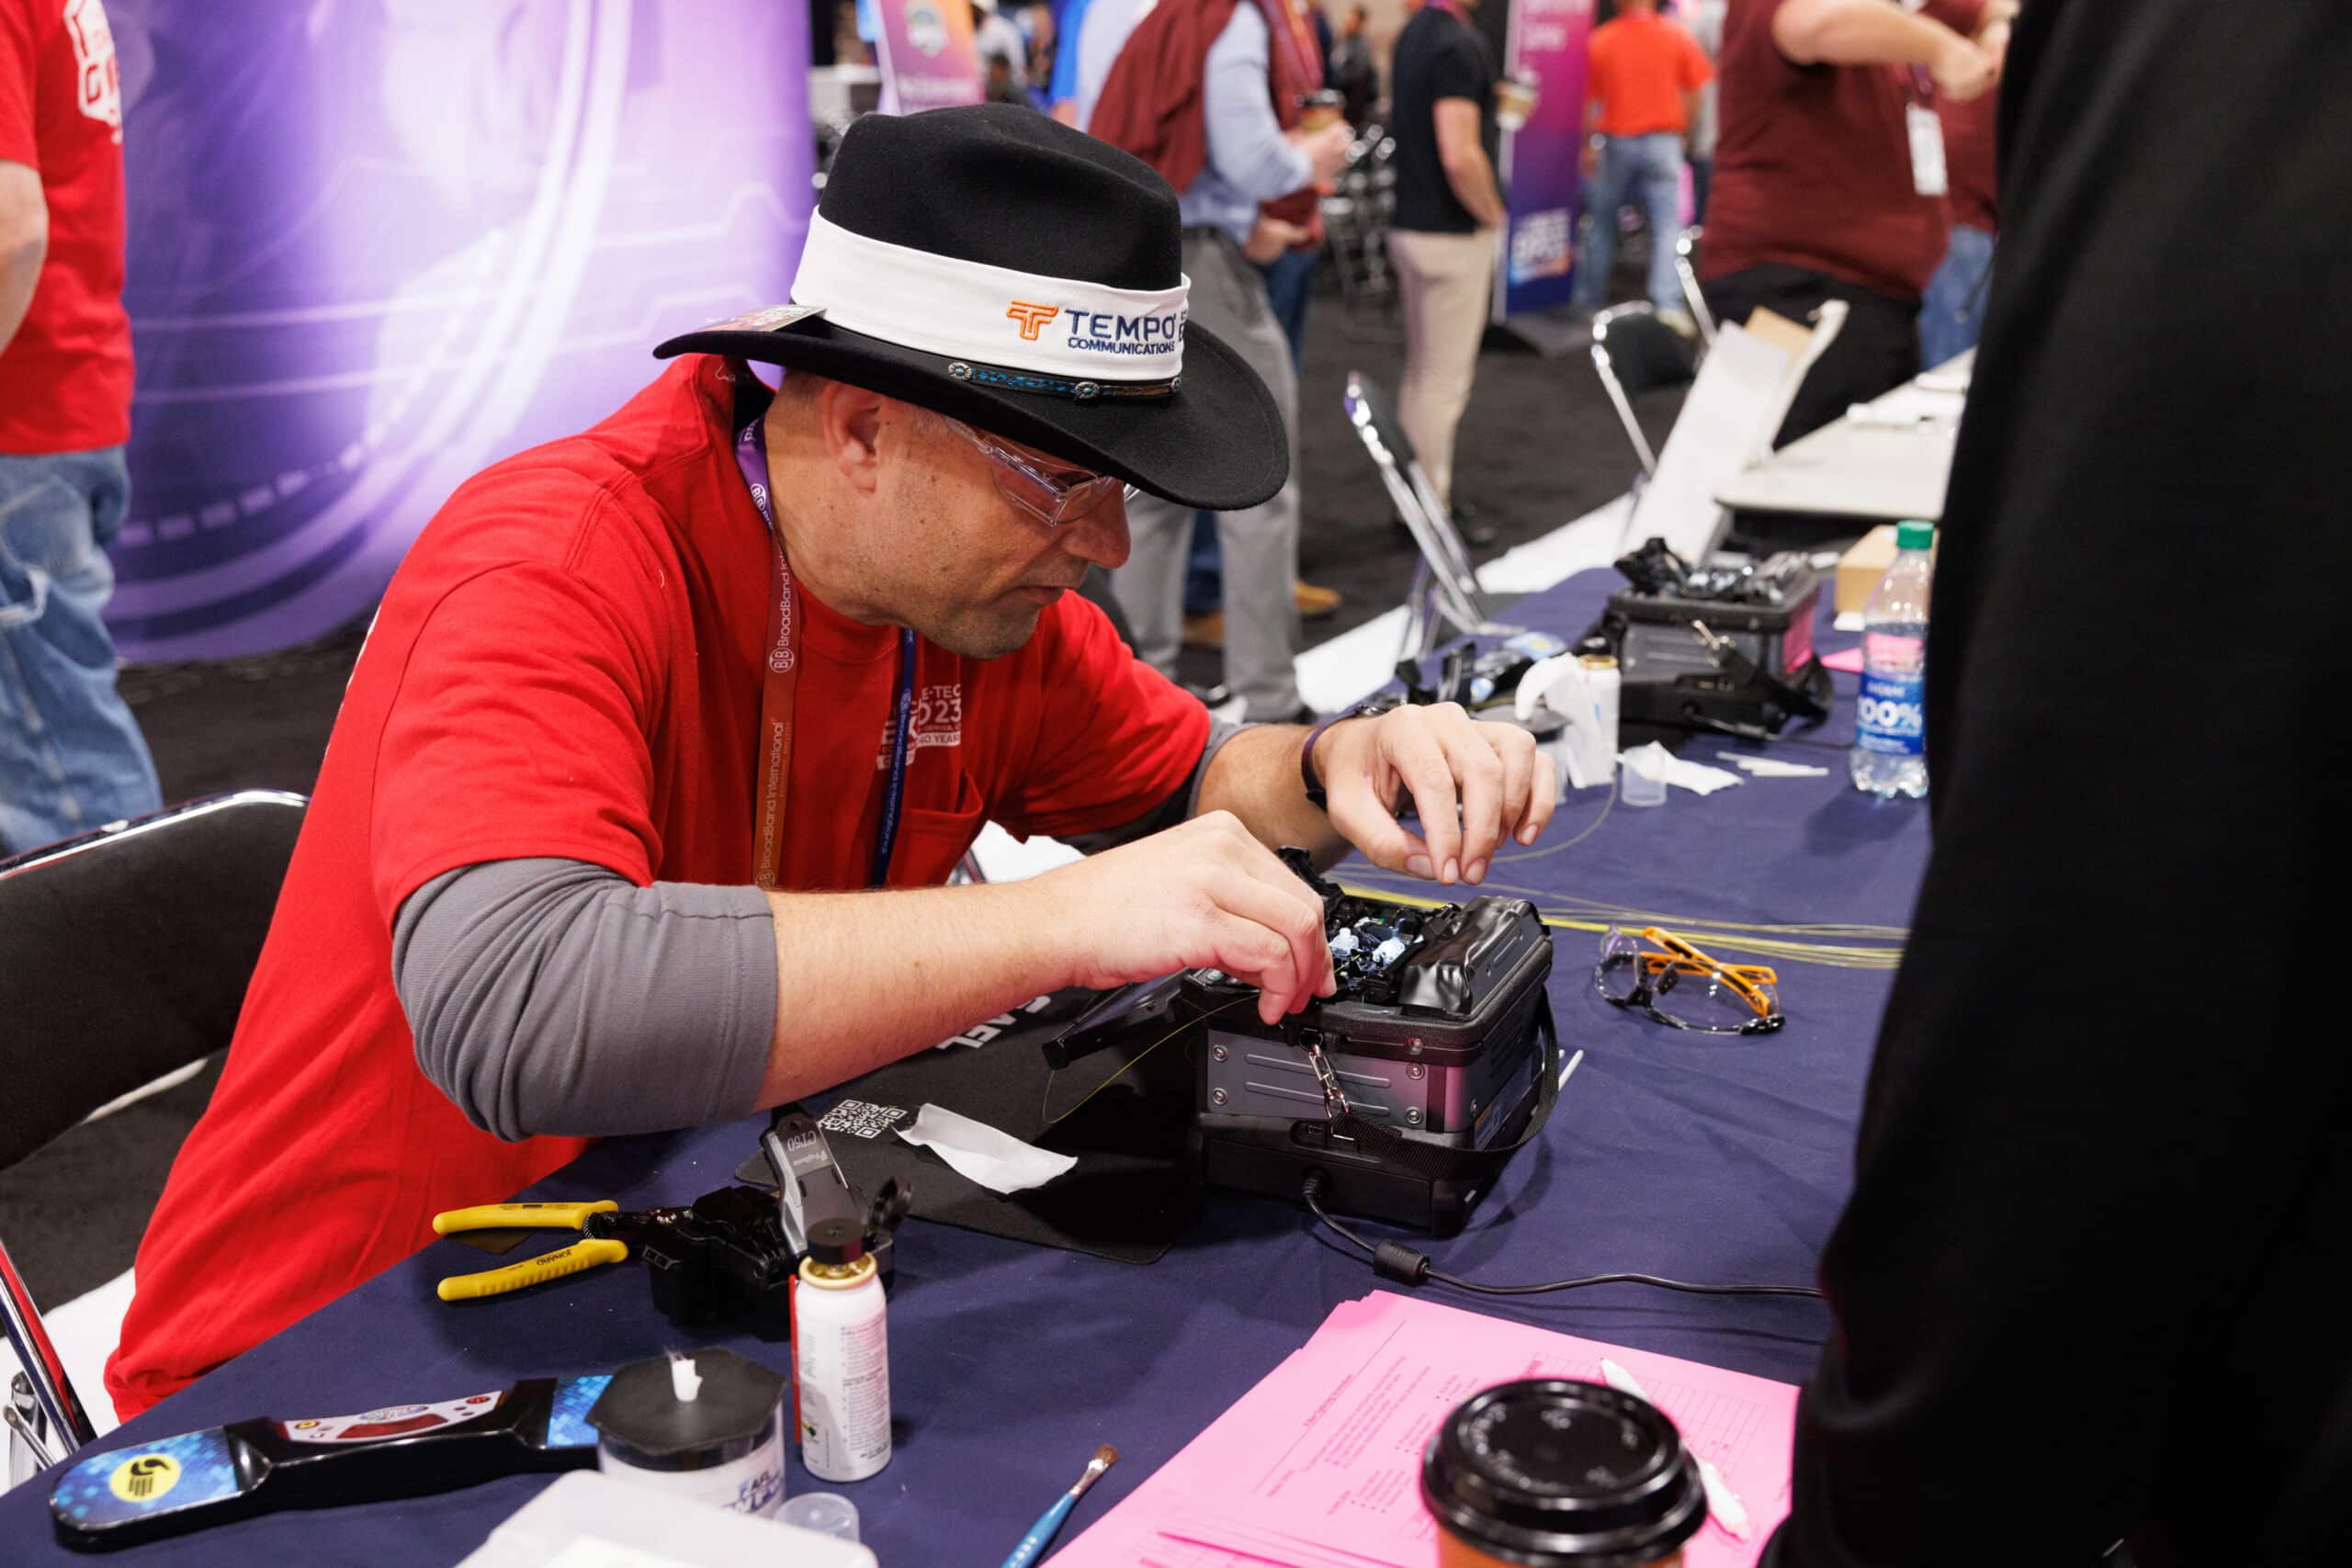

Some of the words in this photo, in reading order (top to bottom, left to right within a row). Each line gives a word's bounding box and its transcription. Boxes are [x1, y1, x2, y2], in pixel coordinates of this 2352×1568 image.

[1065, 308, 1176, 342] TEMPO
[1068, 336, 1175, 355] COMMUNICATIONS
[777, 571, 791, 647] BroadBand
[766, 722, 785, 798] International
[761, 799, 776, 868] BroadBand
